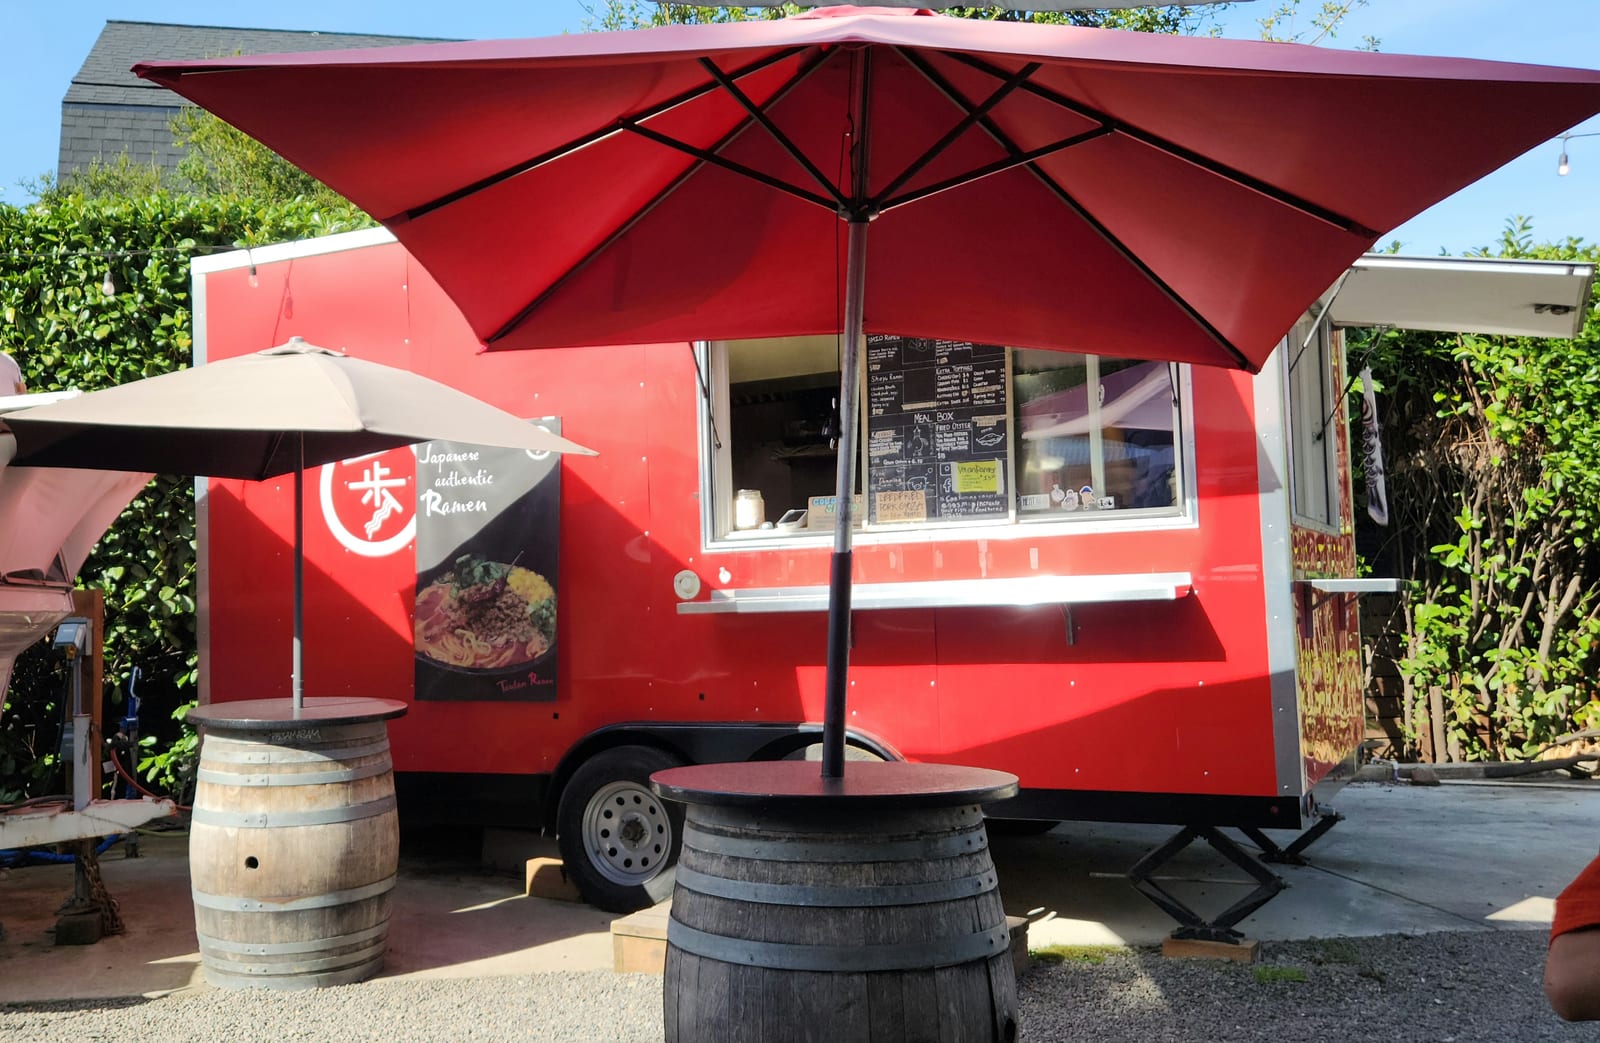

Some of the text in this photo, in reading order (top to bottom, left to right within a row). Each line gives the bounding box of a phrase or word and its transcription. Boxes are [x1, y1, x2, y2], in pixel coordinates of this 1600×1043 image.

[914, 412, 954, 424] MEAL BOX
[419, 443, 479, 473] Japanese
[434, 469, 494, 488] authentic
[420, 488, 487, 517] Ramen
